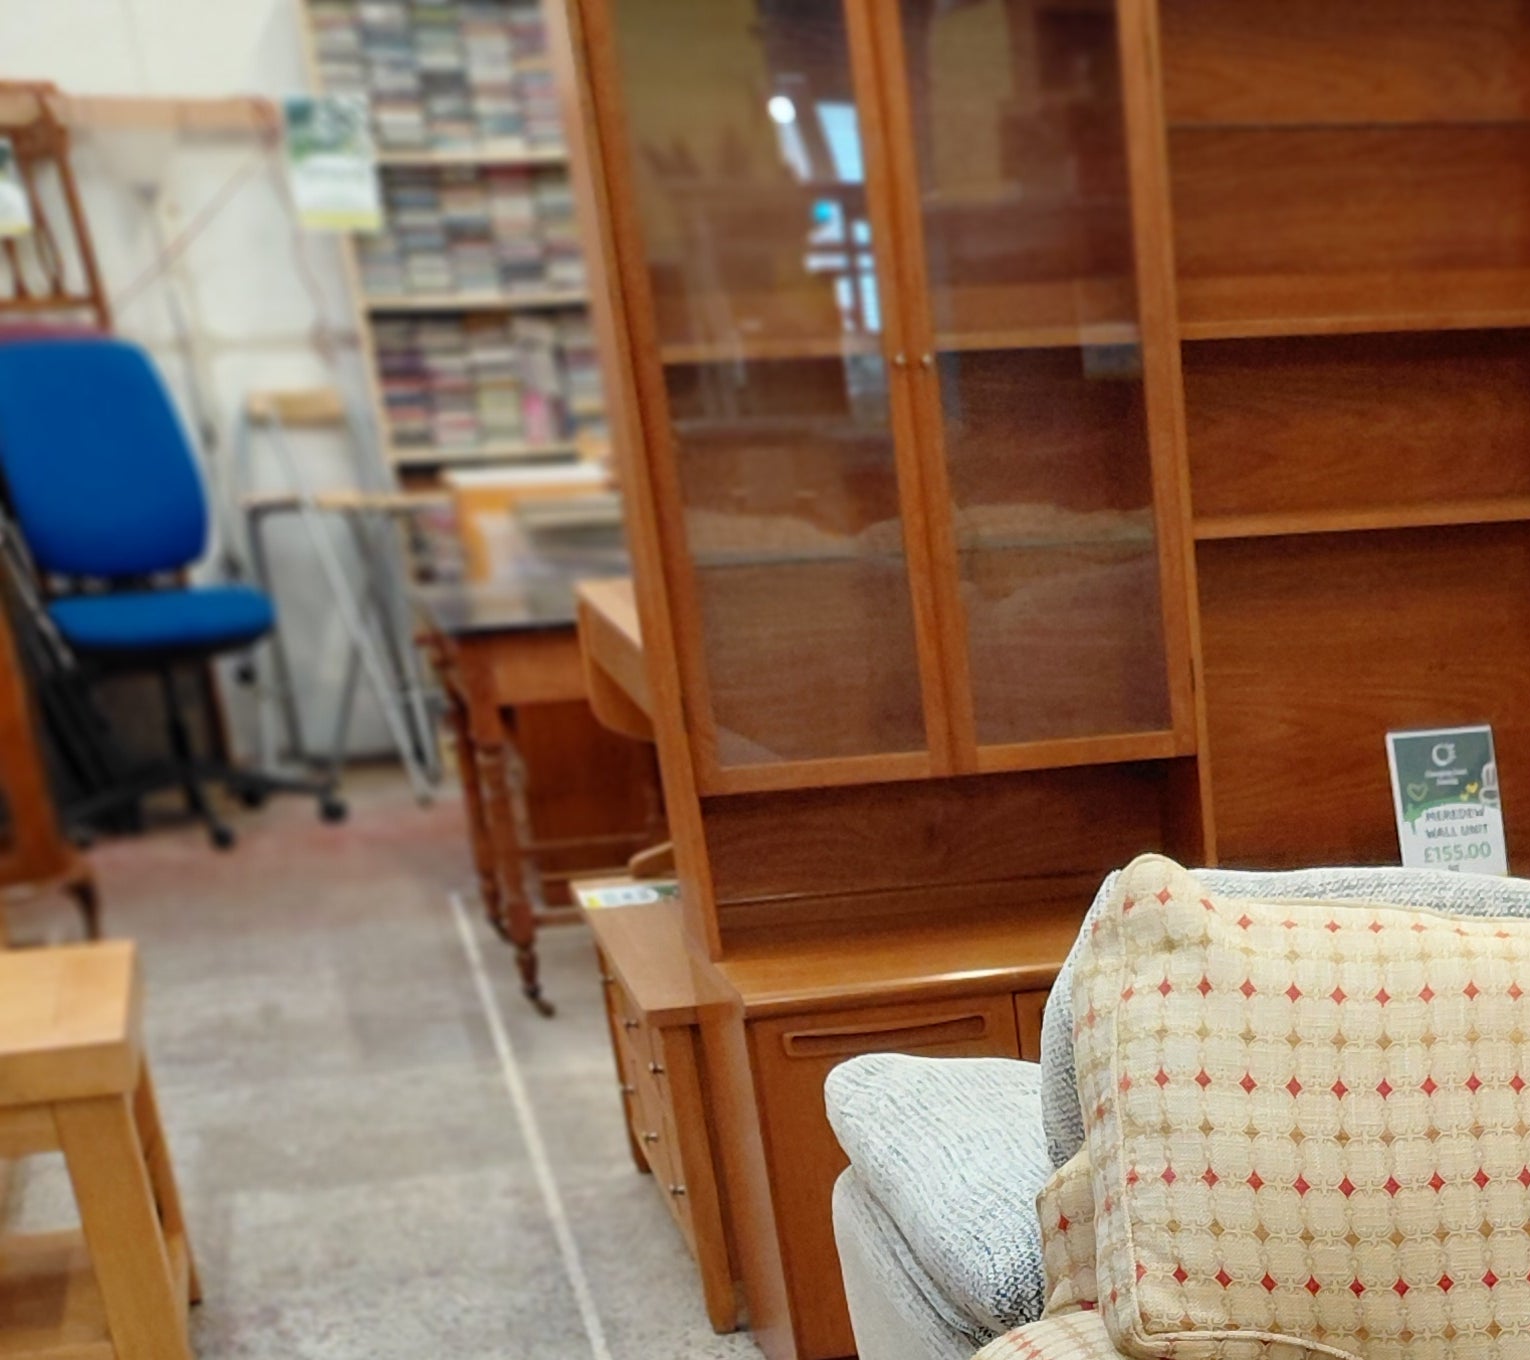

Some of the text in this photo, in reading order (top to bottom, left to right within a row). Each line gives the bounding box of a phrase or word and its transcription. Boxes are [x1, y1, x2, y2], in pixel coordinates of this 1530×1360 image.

[1425, 824, 1488, 838] WALL UNIT
[1424, 841, 1492, 863] £155.00
